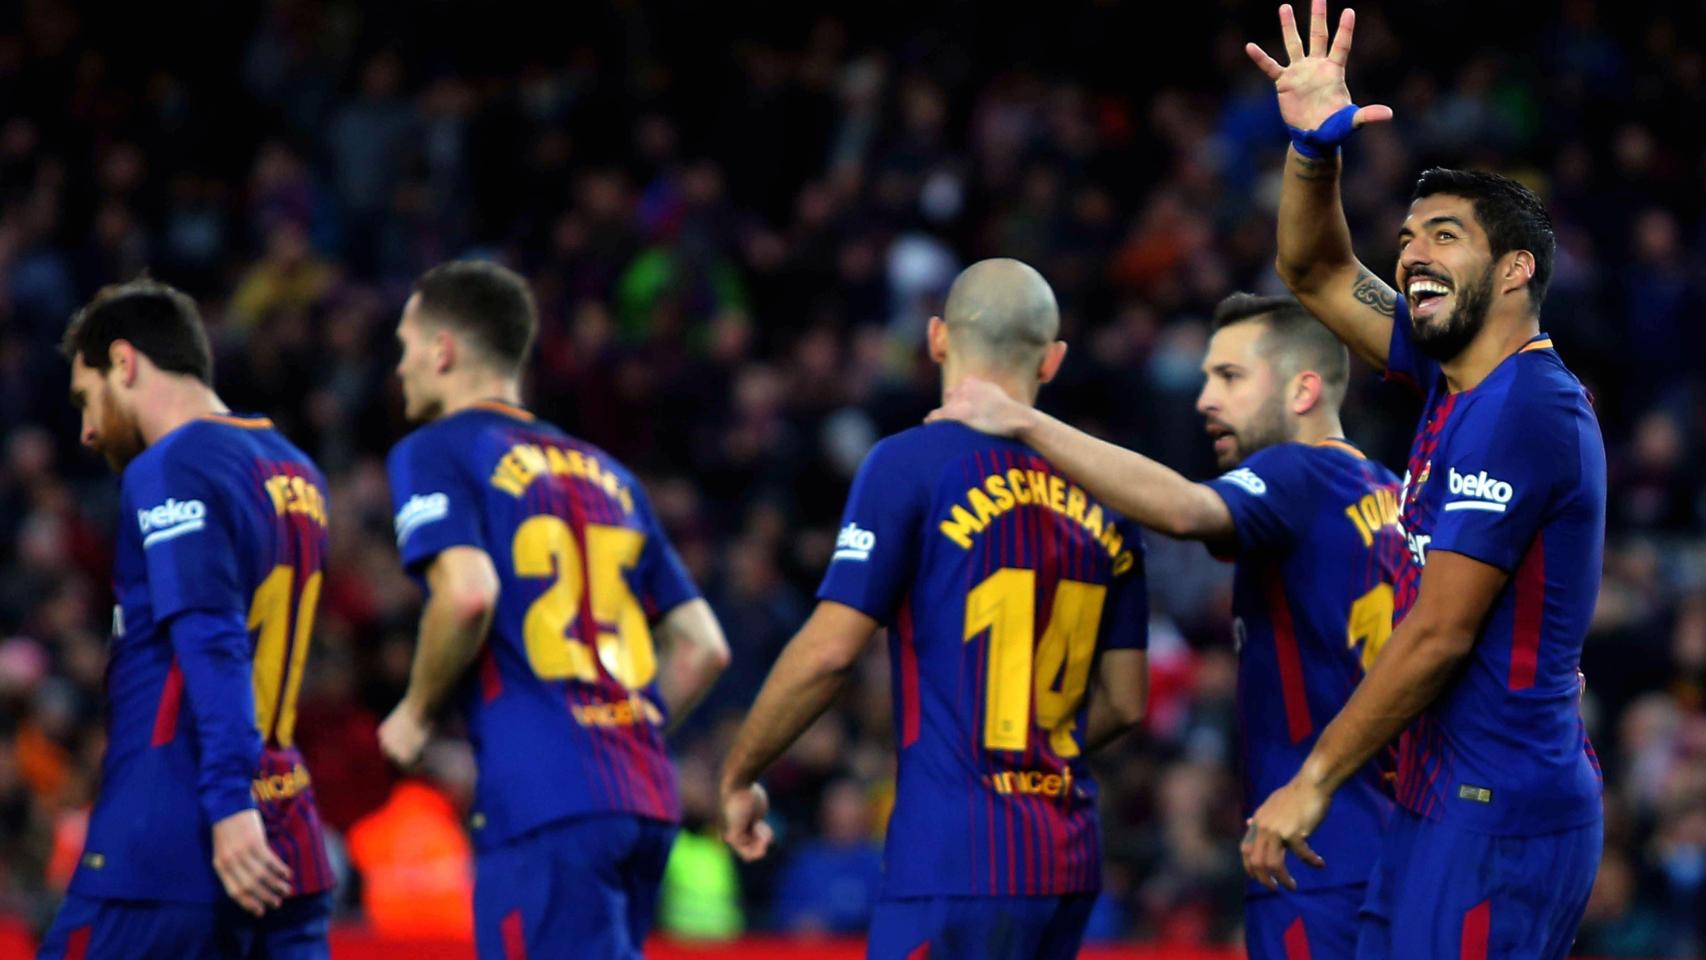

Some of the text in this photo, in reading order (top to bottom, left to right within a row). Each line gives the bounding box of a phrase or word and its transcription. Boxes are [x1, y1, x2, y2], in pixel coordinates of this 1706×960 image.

[137, 497, 206, 534] beko
[836, 521, 876, 551] eko
[939, 468, 1134, 577] MASCHERANO
[1448, 467, 1513, 503] beko
[248, 564, 322, 748] 11
[512, 514, 657, 689] 25
[963, 567, 1107, 758] 14
